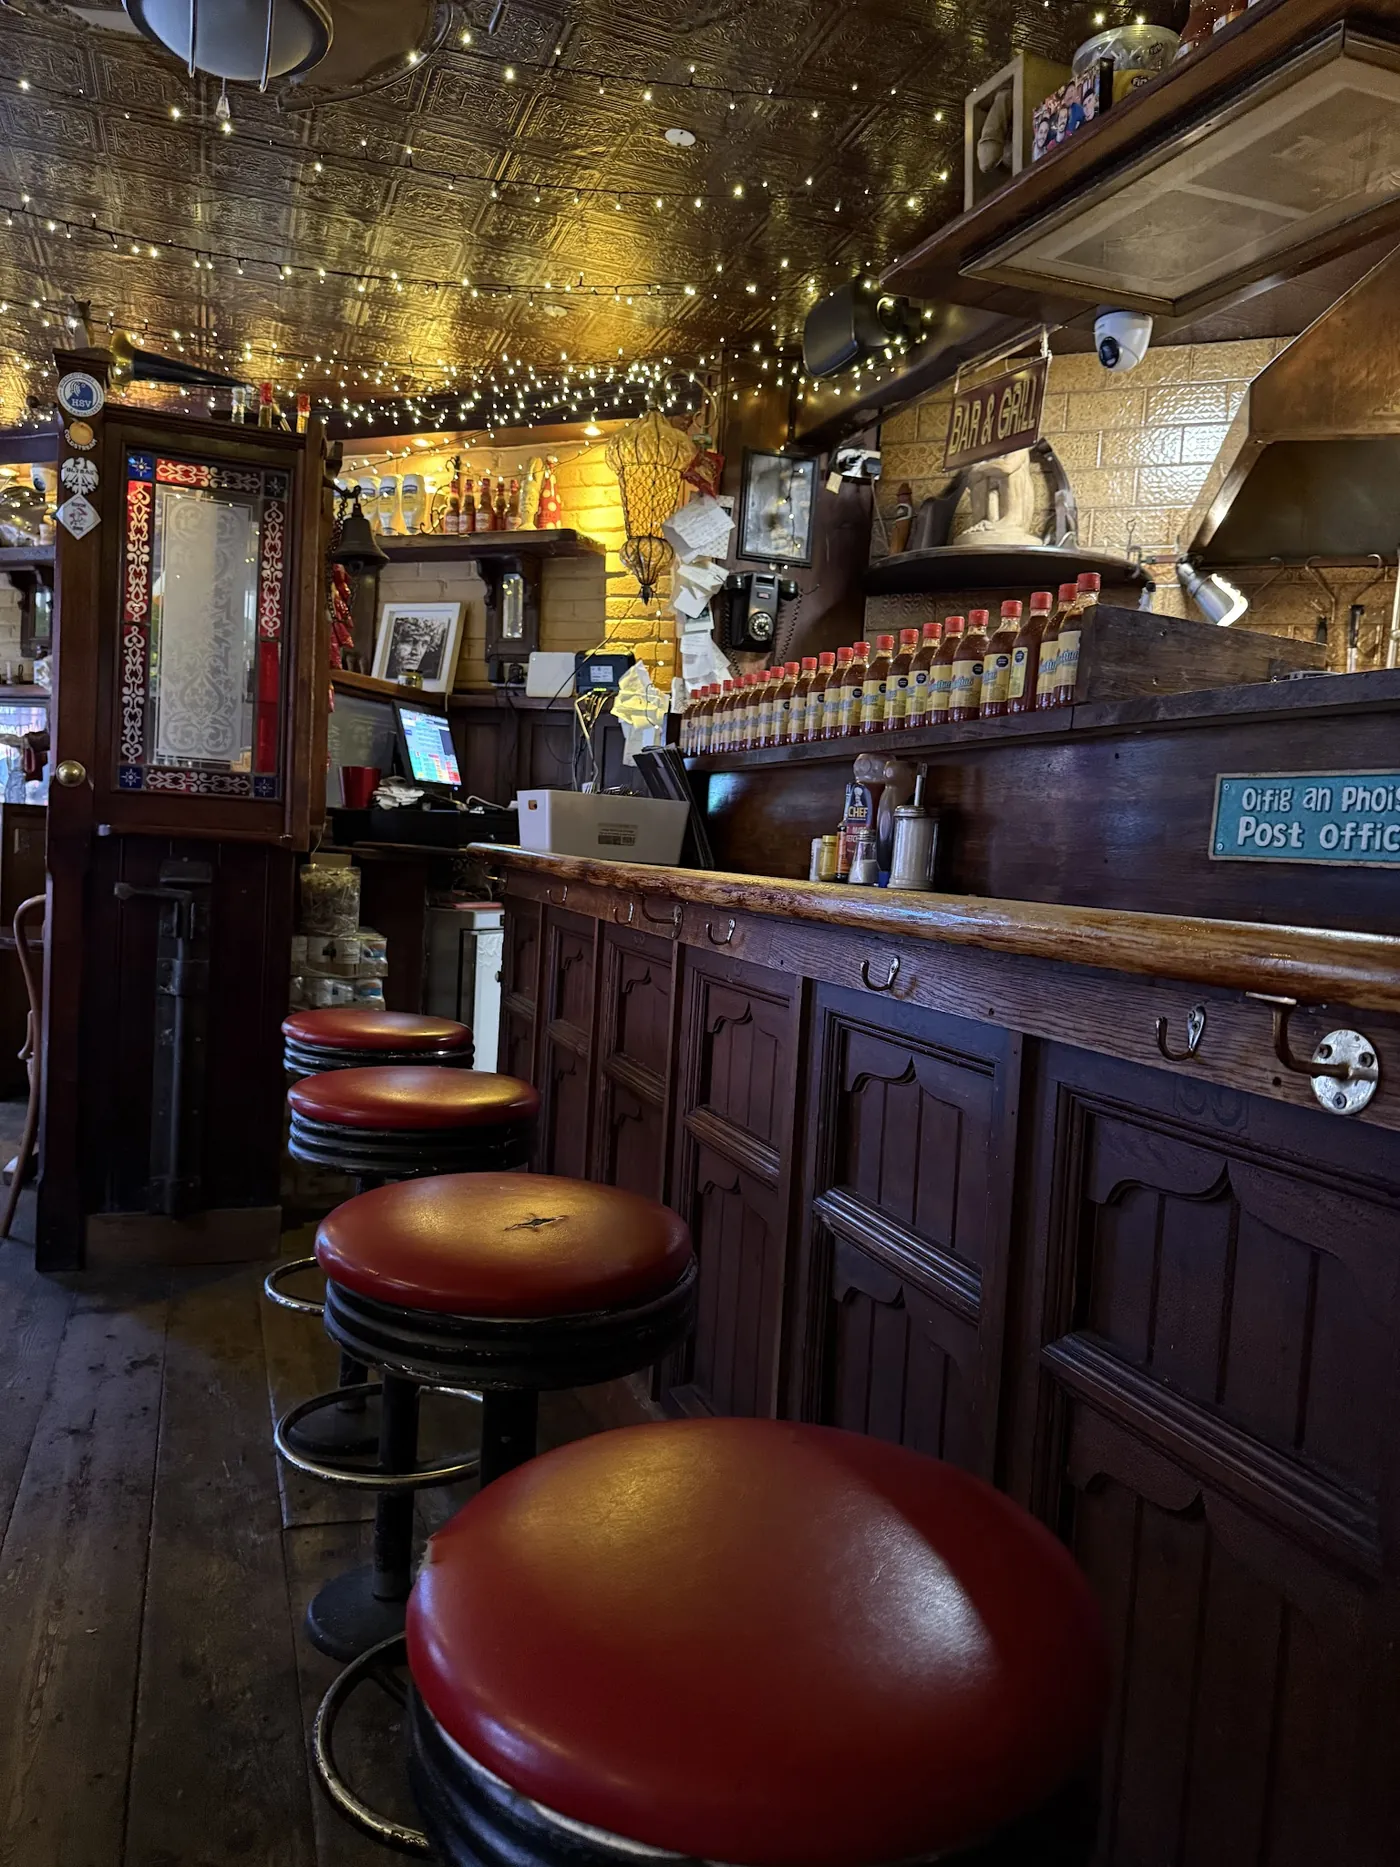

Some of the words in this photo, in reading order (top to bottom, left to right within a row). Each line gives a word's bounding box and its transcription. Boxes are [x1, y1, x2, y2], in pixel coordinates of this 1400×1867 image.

[71, 398, 92, 408] HSV
[948, 400, 982, 456] BAR
[981, 393, 996, 446] &
[997, 376, 1037, 440] GRILL
[848, 806, 869, 818] CHEF
[1242, 787, 1293, 812] Oifig
[1303, 786, 1332, 812] an
[1237, 816, 1303, 848] Post
